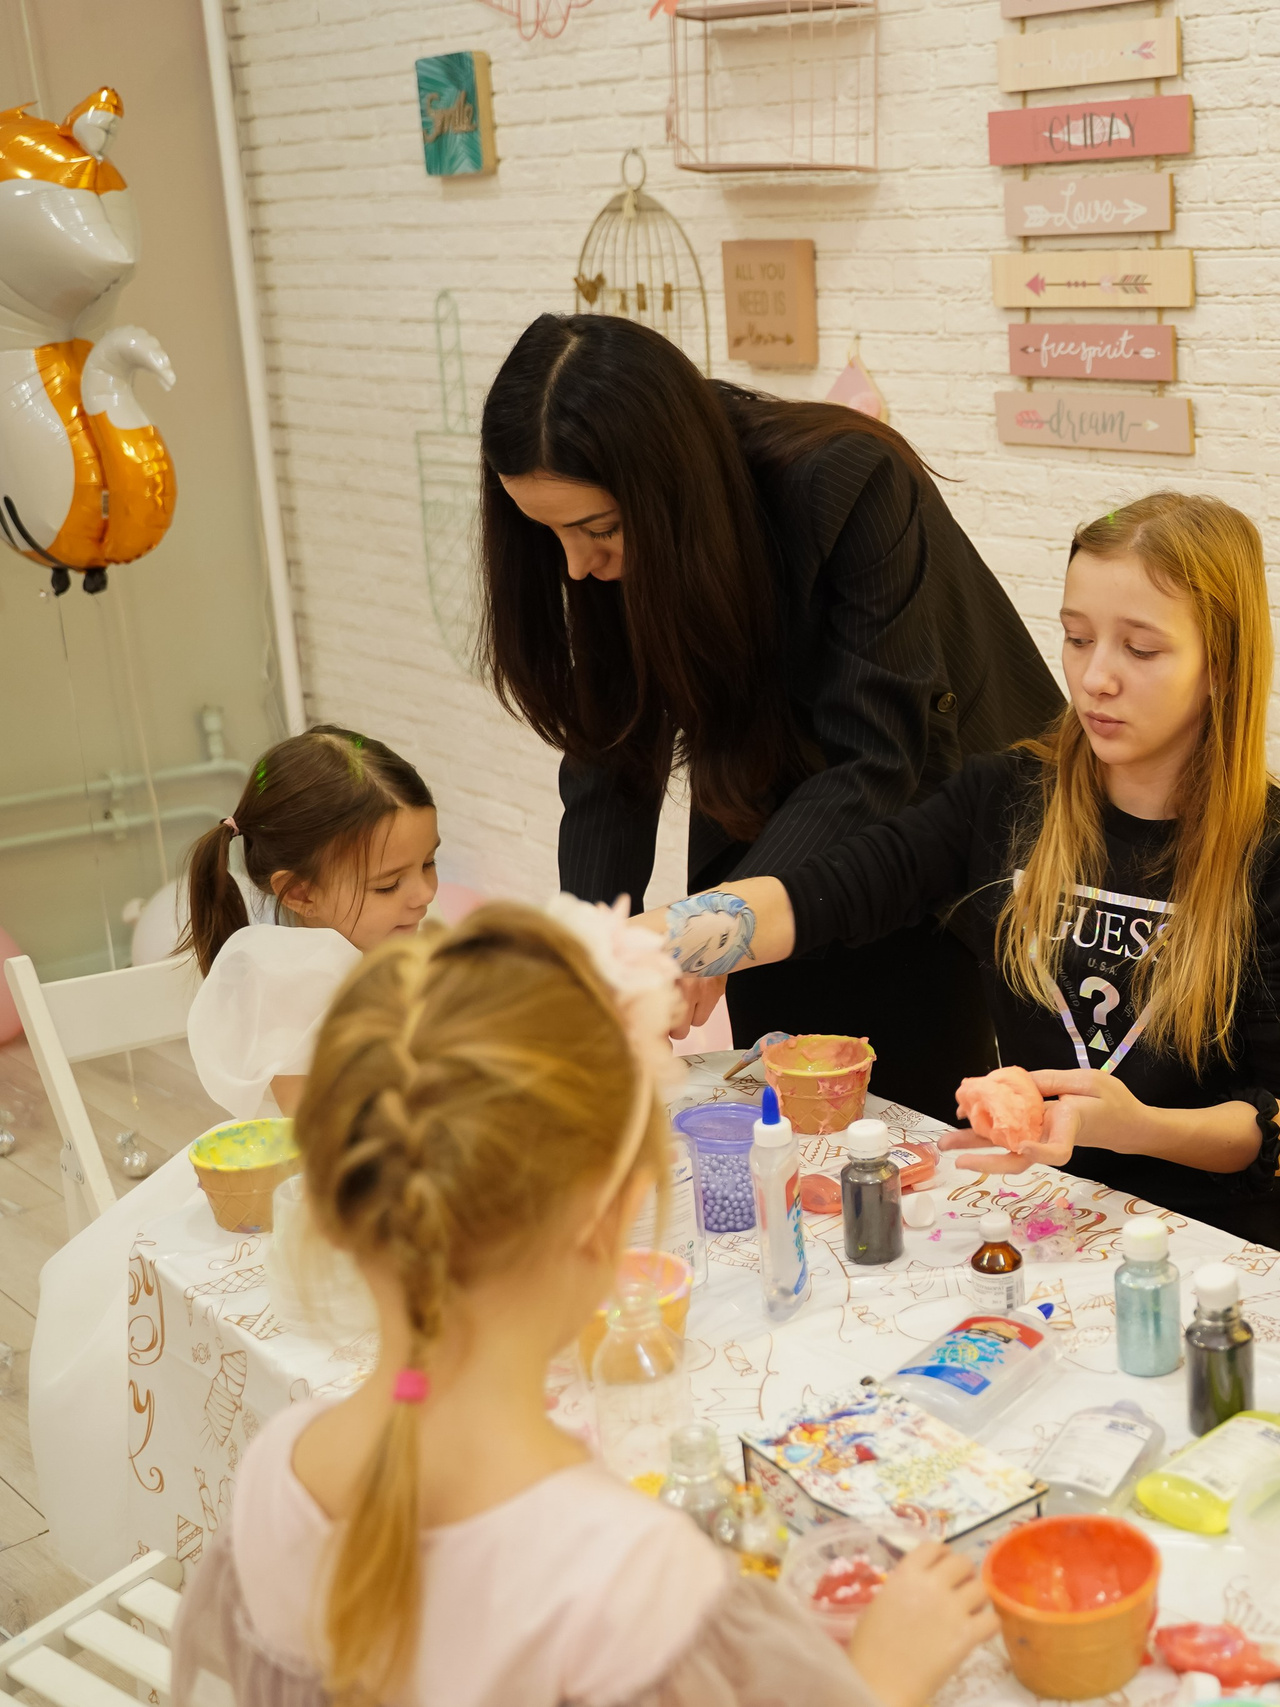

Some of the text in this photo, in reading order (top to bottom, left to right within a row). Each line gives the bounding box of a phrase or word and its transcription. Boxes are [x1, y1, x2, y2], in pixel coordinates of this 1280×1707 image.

[1050, 38, 1113, 81] hope
[1032, 111, 1138, 154] HOLIDAY
[1053, 182, 1115, 230] Love
[735, 262, 786, 281] ALL YOU
[1048, 399, 1131, 444] dream
